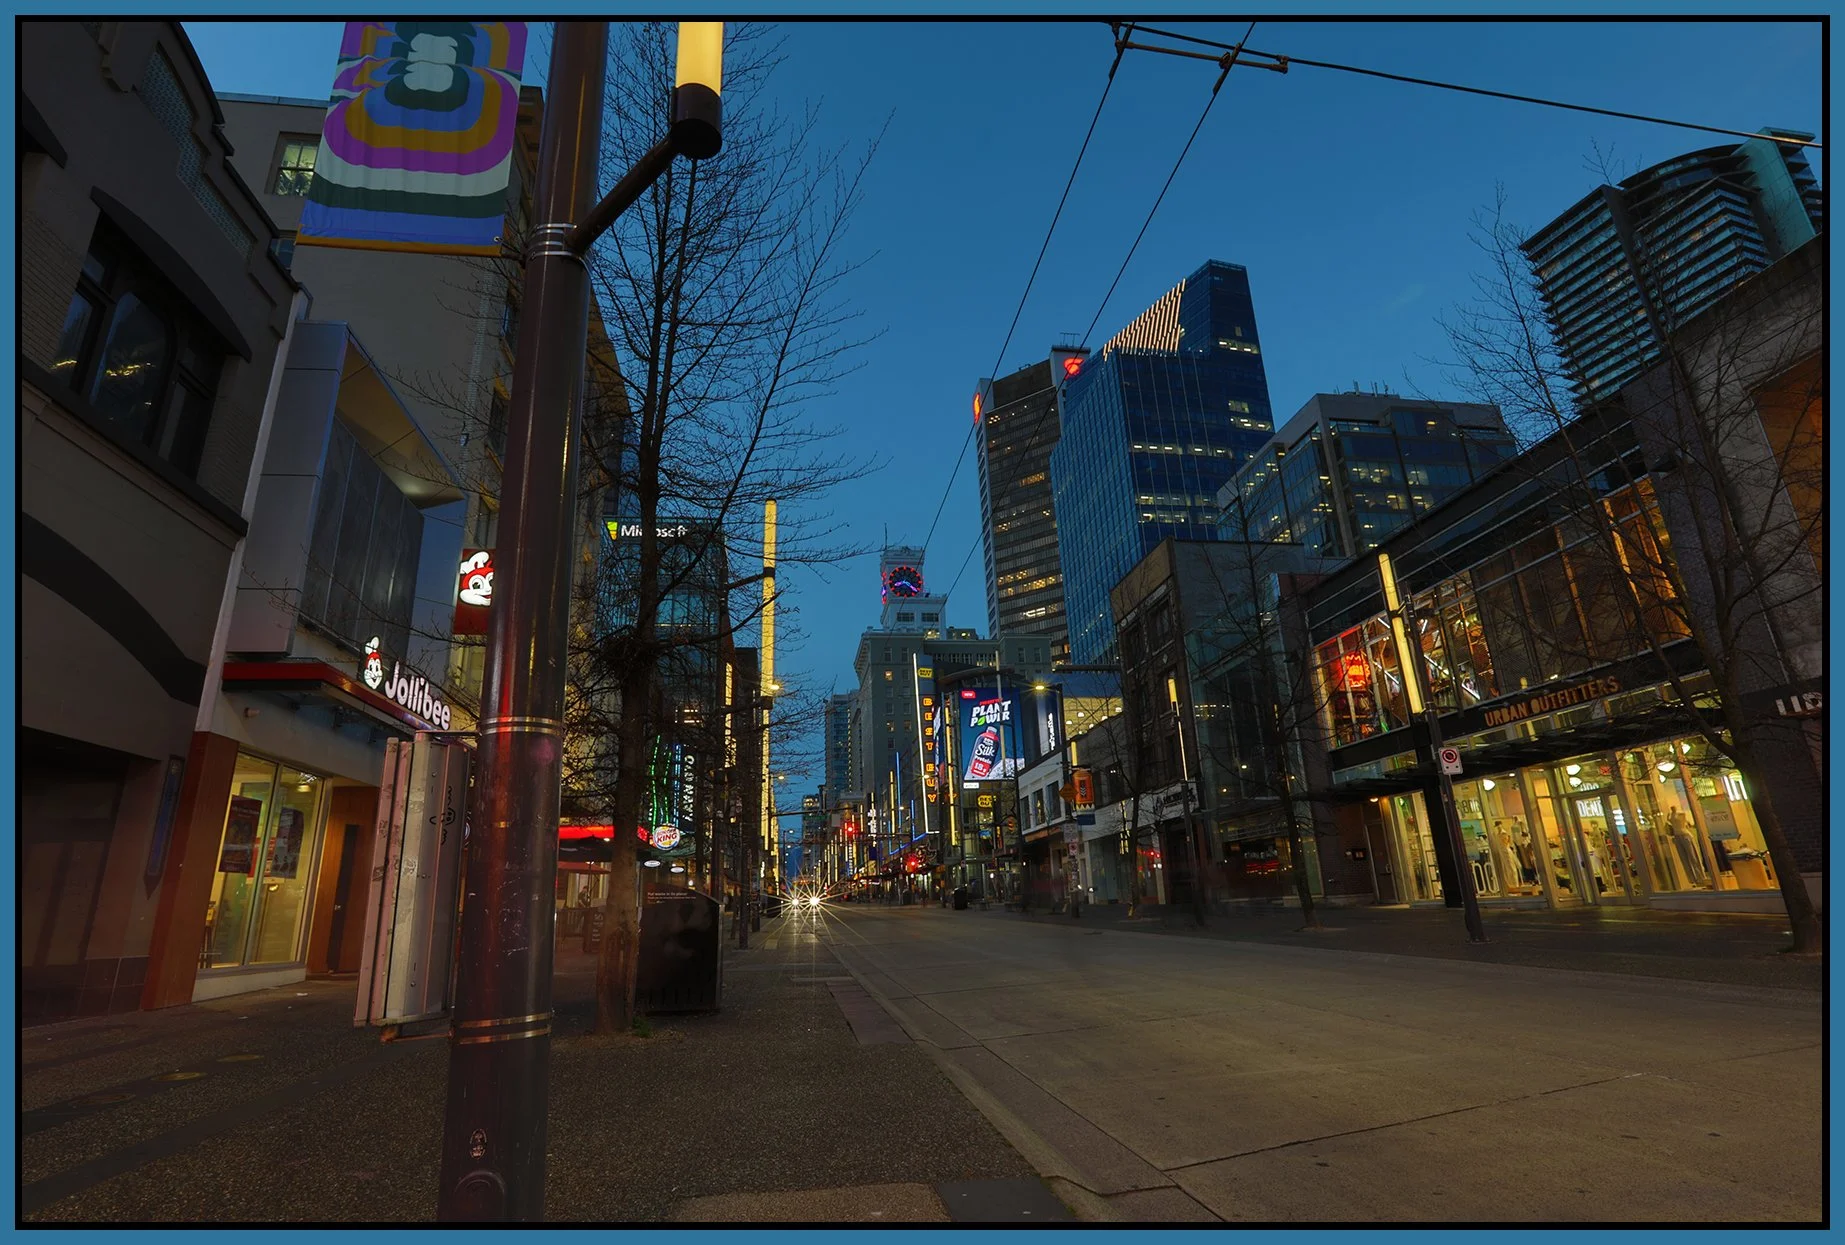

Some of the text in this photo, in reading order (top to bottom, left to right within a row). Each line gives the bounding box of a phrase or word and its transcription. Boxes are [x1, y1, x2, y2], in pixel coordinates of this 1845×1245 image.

[384, 660, 451, 731] Jollibee
[971, 700, 1012, 717] PLANT
[1485, 675, 1622, 727] URBAN OUTFITTERS
[922, 697, 937, 803] BEST BUY
[975, 743, 995, 757] Silk
[657, 832, 677, 843] KING
